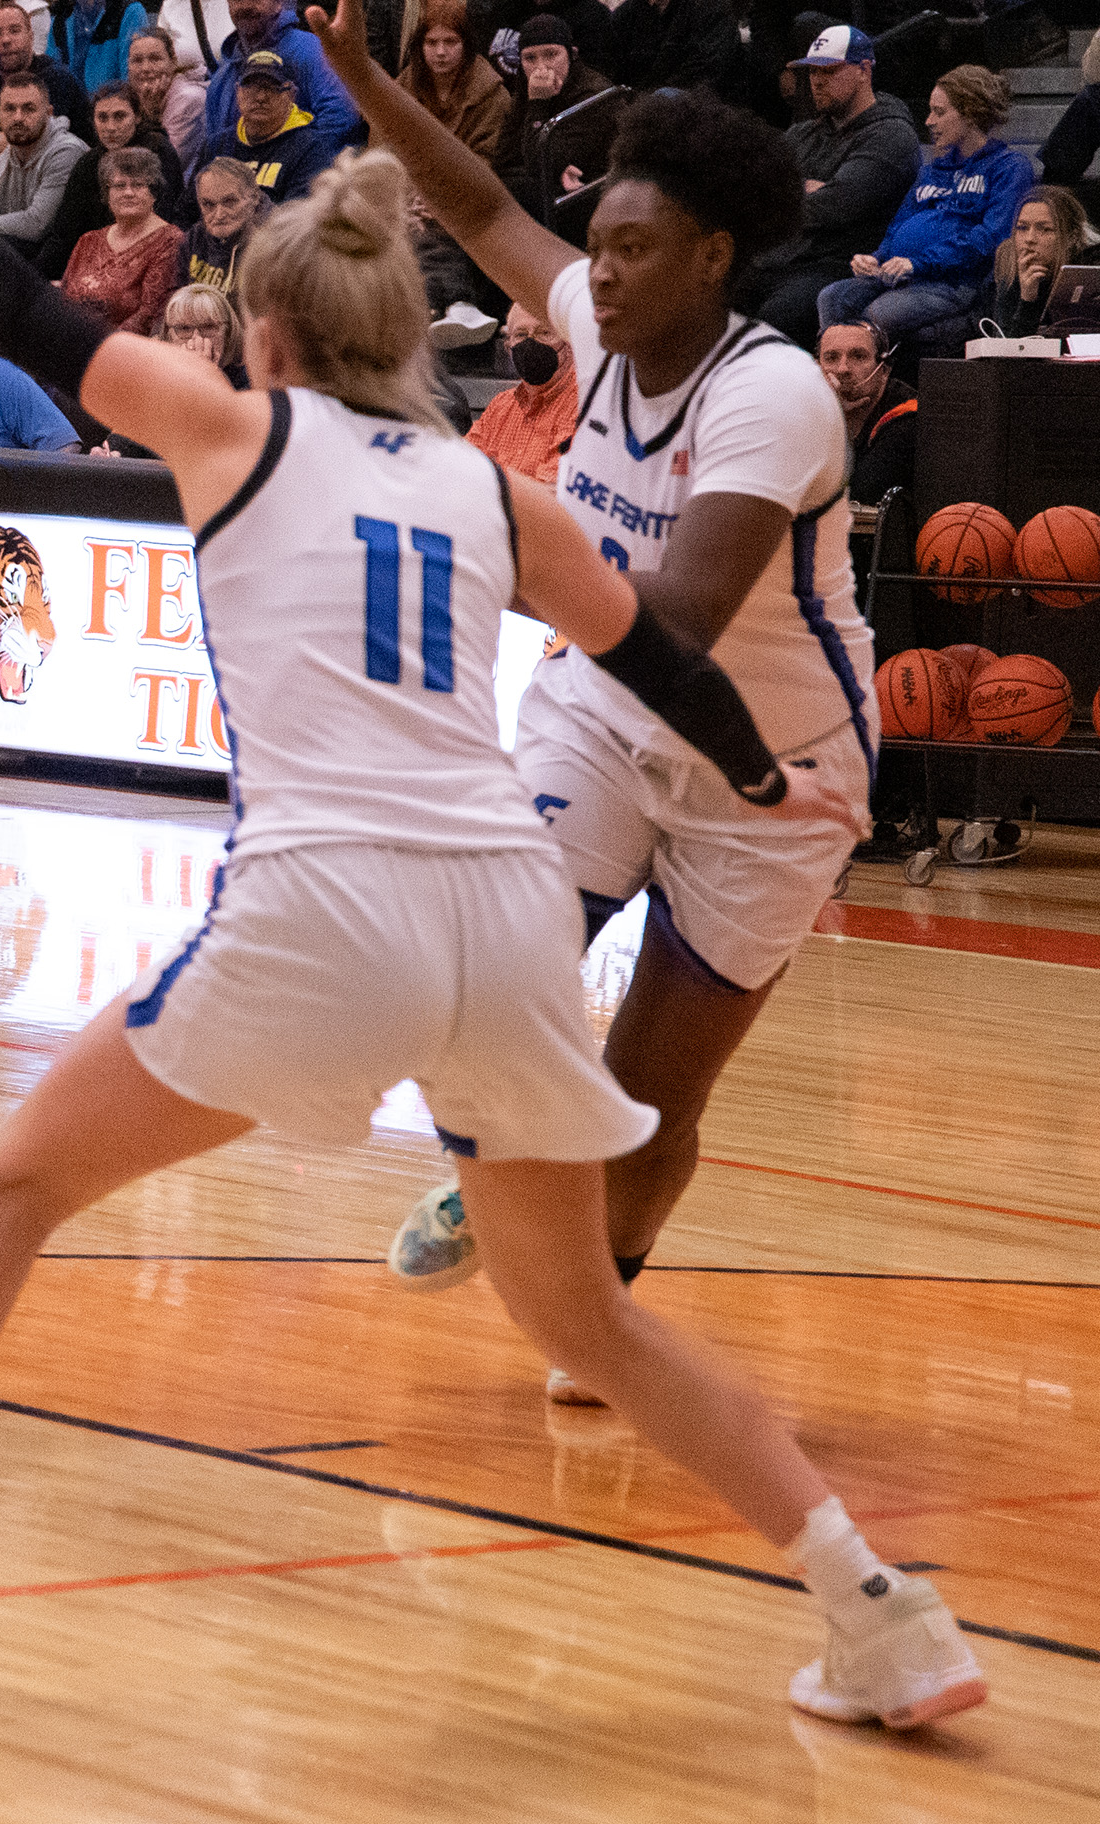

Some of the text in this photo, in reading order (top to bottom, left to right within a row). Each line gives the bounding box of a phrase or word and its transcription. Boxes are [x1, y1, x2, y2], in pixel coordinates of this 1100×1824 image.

[81, 536, 207, 650] FE
[354, 514, 454, 693] 11
[972, 685, 1029, 712] Rawlings
